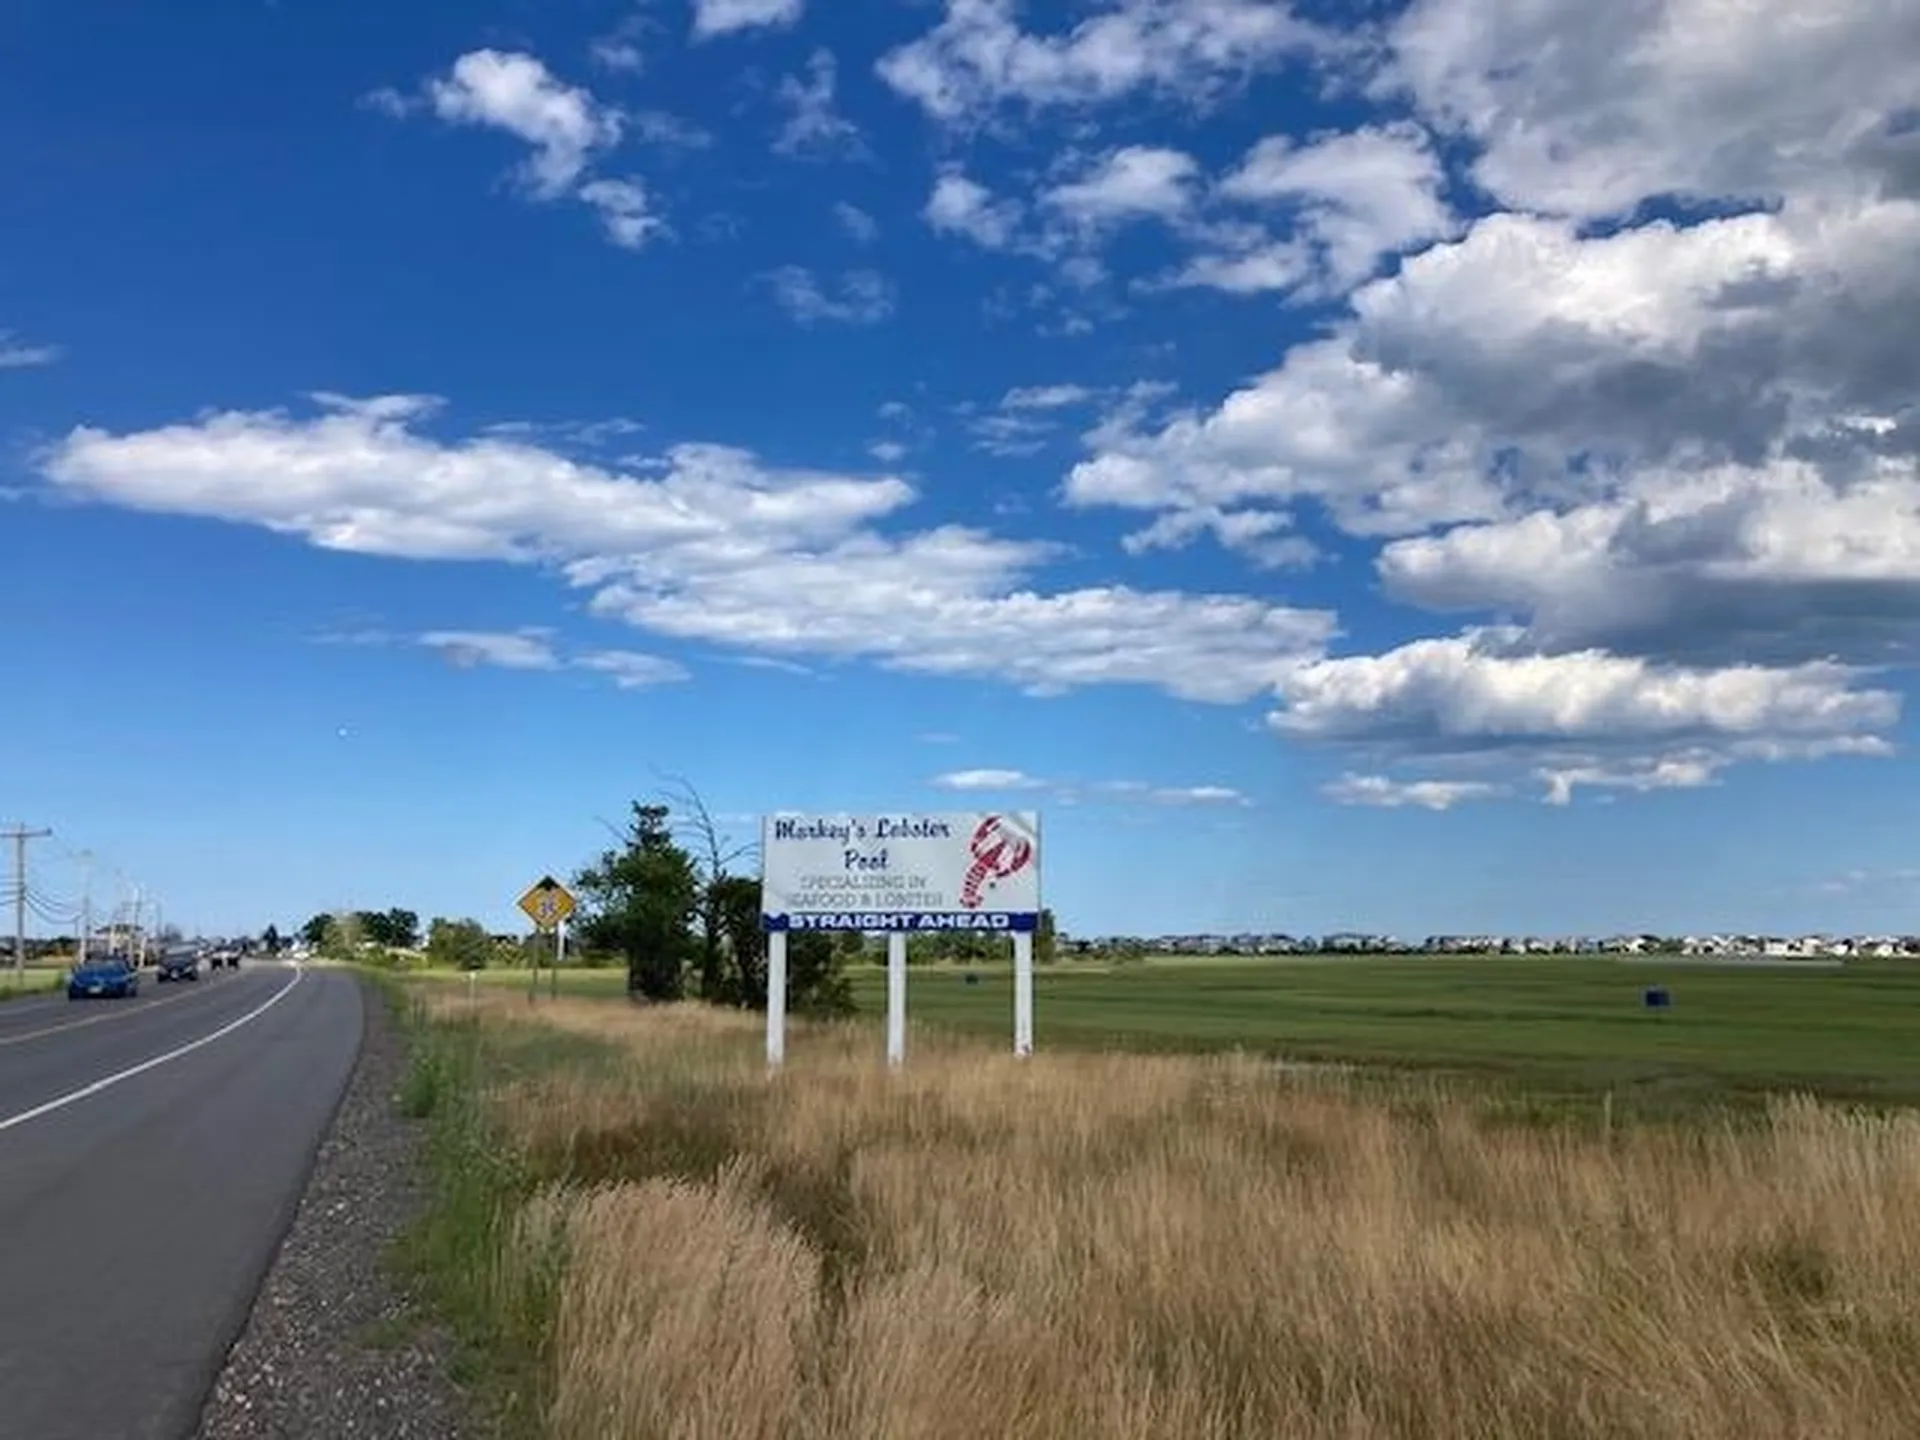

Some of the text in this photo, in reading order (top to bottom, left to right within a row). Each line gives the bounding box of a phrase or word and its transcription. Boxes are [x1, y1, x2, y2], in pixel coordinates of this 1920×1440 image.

[877, 817, 950, 838] Lobster
[788, 913, 1010, 929] STRAIGHT AHEAD
